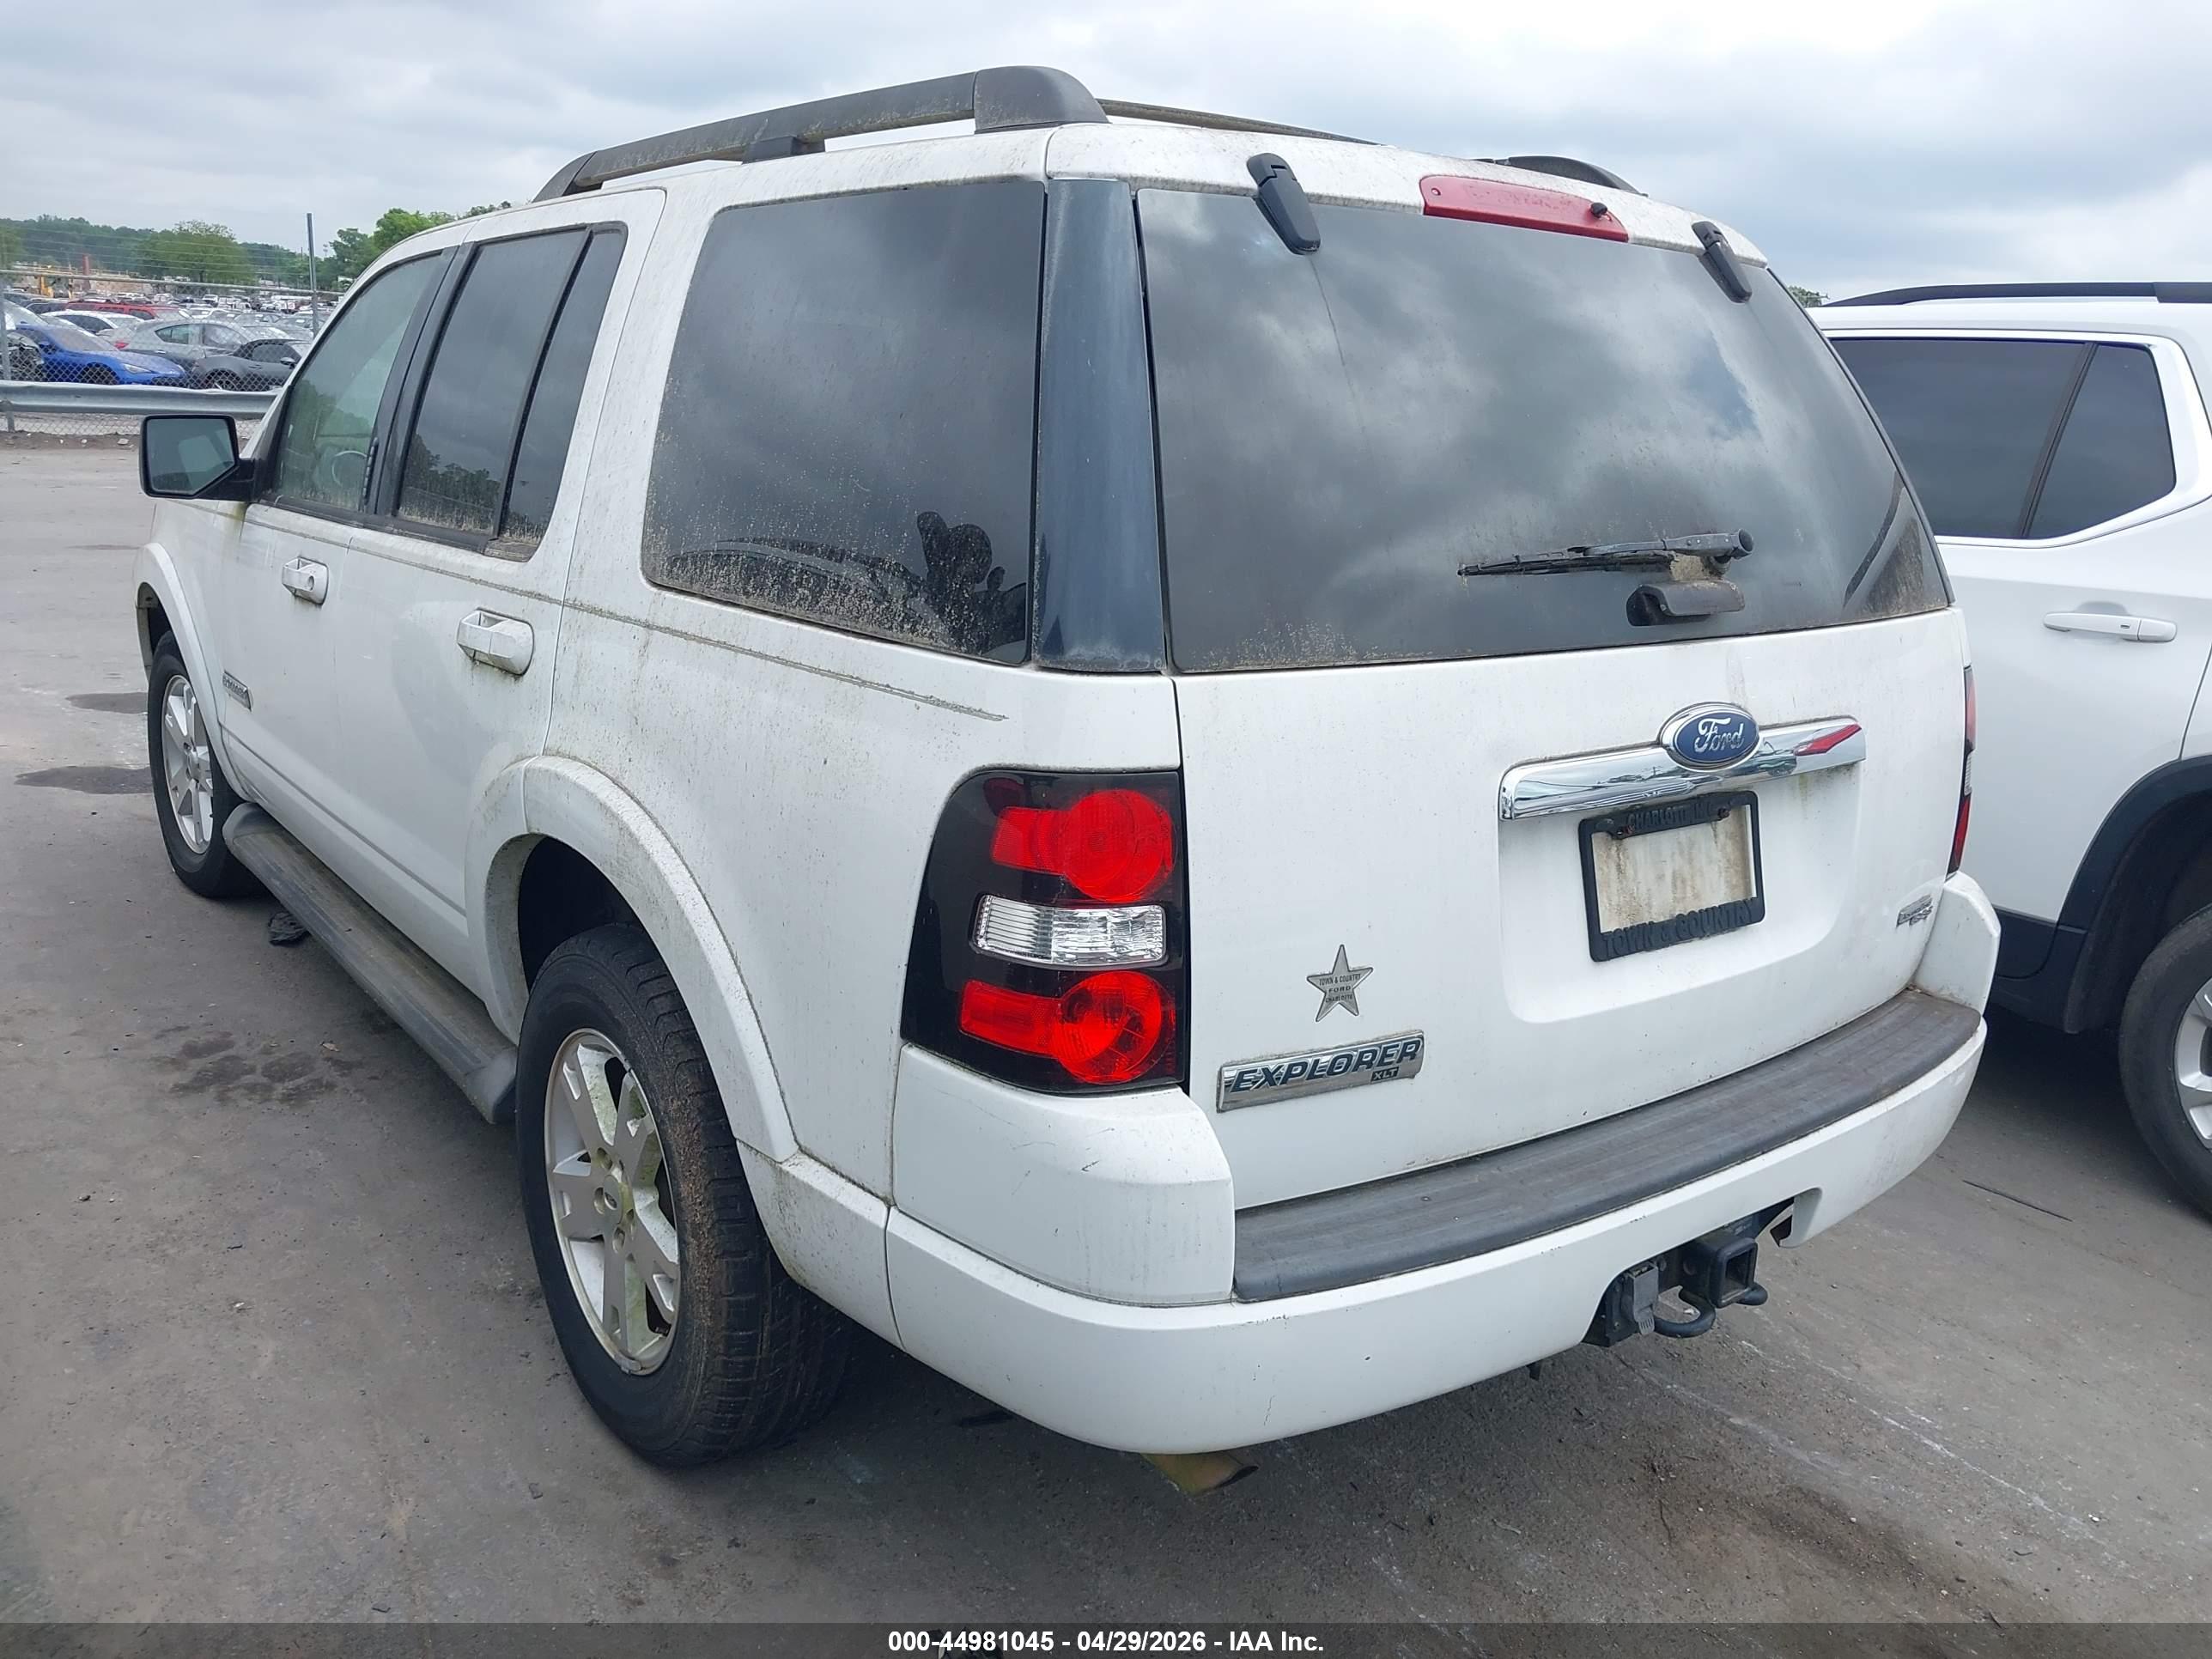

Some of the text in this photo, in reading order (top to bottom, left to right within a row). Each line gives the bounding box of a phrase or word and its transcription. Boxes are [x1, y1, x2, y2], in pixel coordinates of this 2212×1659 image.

[1694, 717, 1745, 753] Ford
[1602, 921, 1656, 958] TOWN
[1675, 896, 1757, 941] COUNTRY
[1319, 976, 1333, 986] TOWN
[1340, 973, 1360, 983] COUNTRY
[1230, 1037, 1424, 1094] EXPLORER
[1372, 1067, 1399, 1083] XLT
